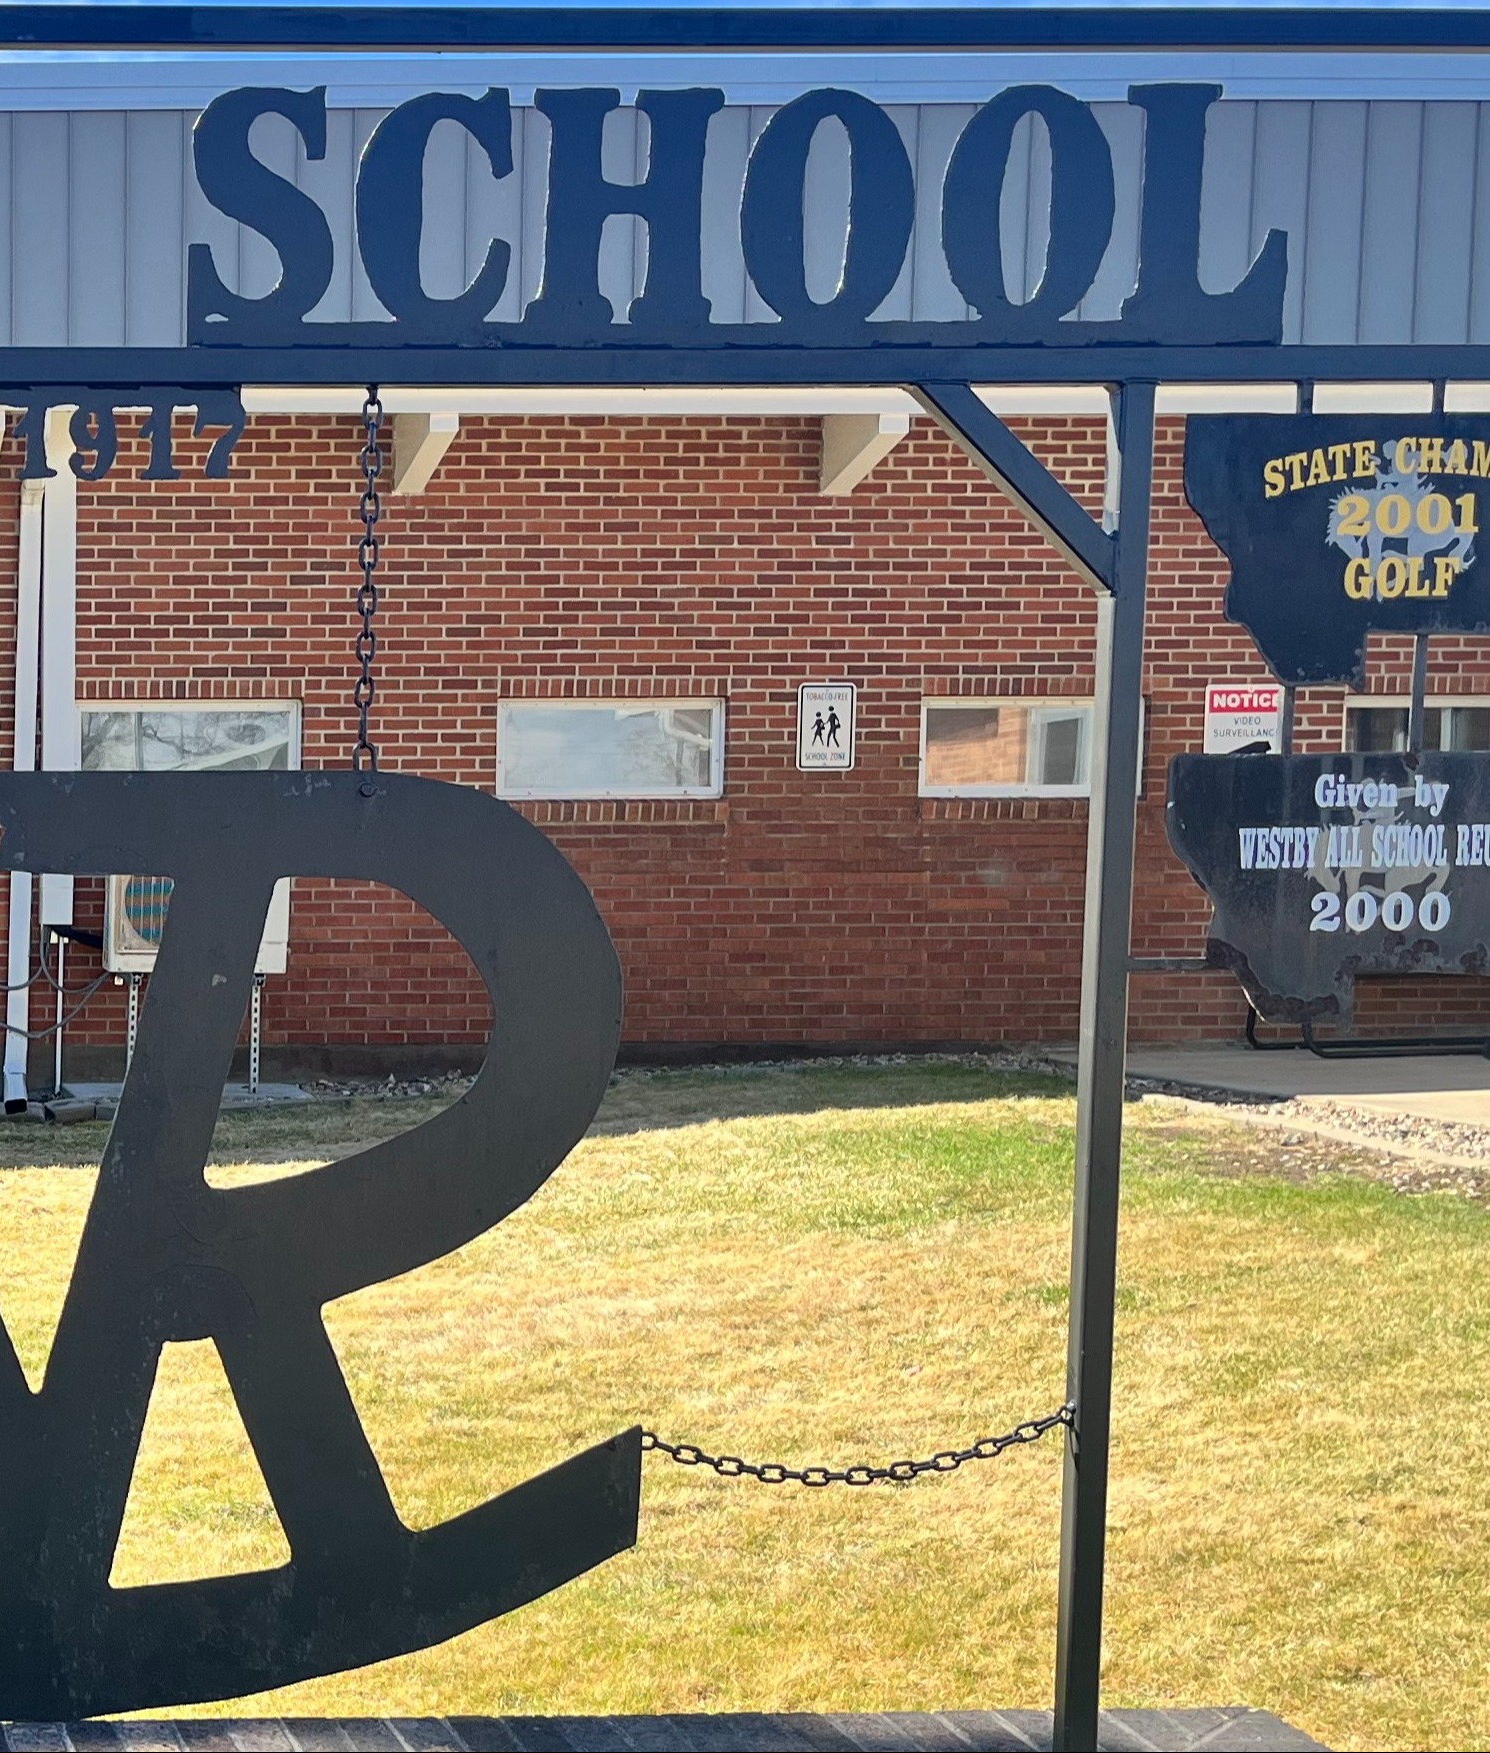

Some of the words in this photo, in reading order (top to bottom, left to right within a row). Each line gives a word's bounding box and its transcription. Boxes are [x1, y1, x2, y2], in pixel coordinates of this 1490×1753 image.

[188, 84, 1288, 336] SCHOOL
[14, 398, 246, 480] 1917
[1263, 440, 1376, 498] STATE
[1336, 493, 1479, 536] 2001
[1343, 556, 1460, 600] GOLF
[1213, 728, 1278, 738] SURVEILLANC
[1234, 716, 1261, 726] VIDEO
[805, 751, 828, 761] SCHOOL
[830, 751, 846, 761] ZONE
[1315, 773, 1398, 808] Given
[1415, 774, 1450, 817] by
[1238, 826, 1319, 869] WESTBY
[1325, 825, 1363, 868] ALL
[1371, 824, 1448, 867] SCHOOL
[1309, 891, 1451, 932] 2000
